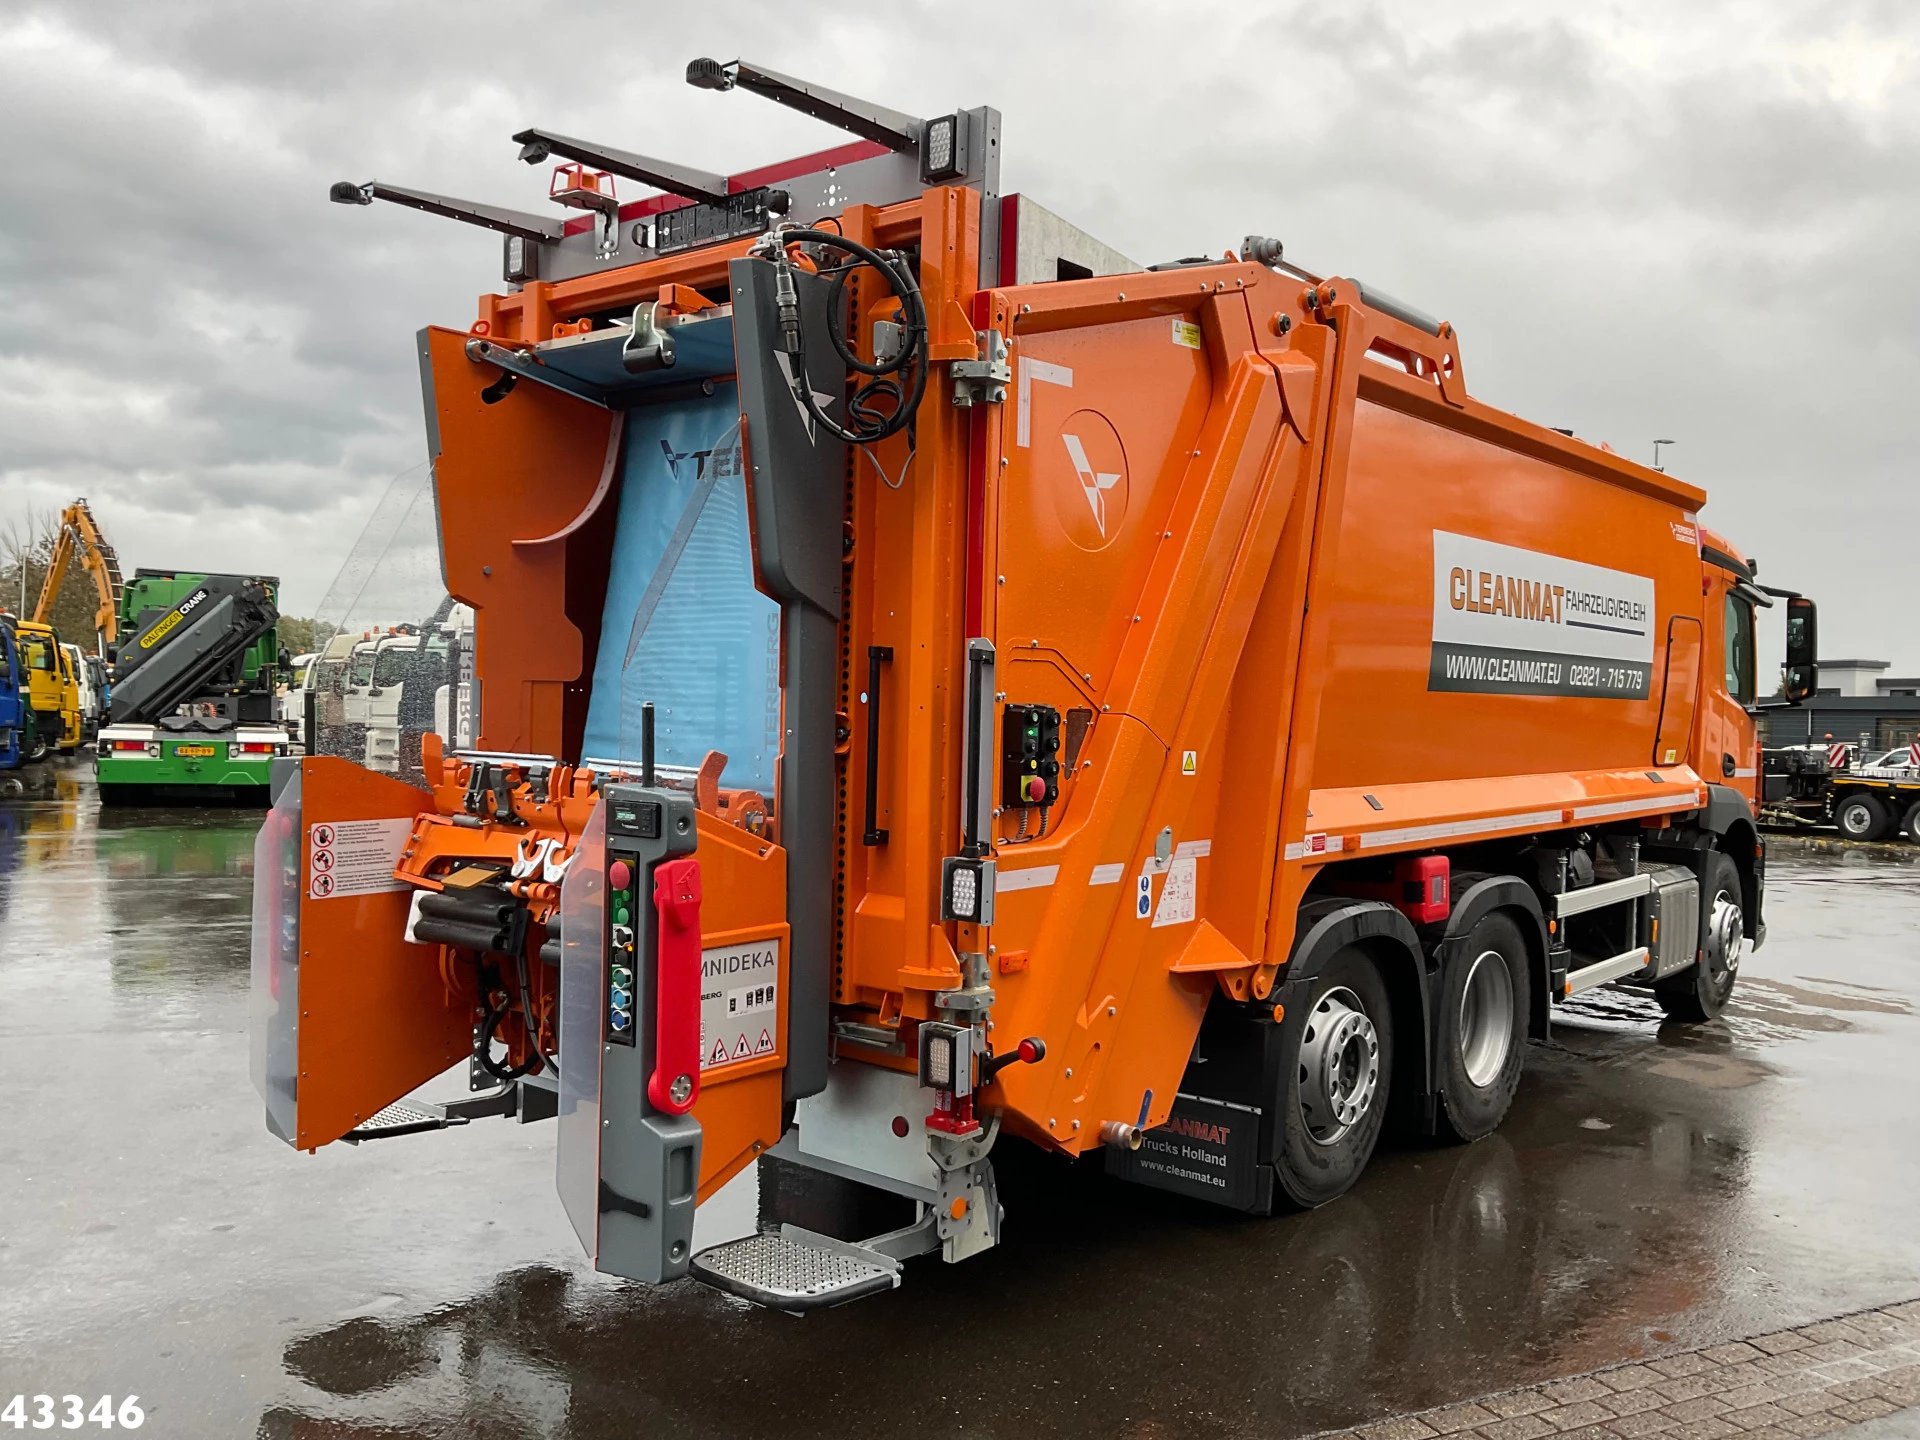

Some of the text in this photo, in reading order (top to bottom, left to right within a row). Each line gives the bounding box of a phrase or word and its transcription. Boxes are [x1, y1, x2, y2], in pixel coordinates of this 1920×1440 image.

[1450, 566, 1646, 624] CLEANMAT FAHRZEUGVERLEIH
[142, 590, 207, 646] PALFINGER CRANE
[1446, 654, 1562, 685] WWW.CLEANMAT.EU
[1569, 665, 1600, 687] 02821
[1607, 668, 1626, 689] 715
[1626, 670, 1643, 690] 779
[1141, 1136, 1227, 1167] Trucks Holland
[1140, 1159, 1226, 1188] www.cleanmat.eu
